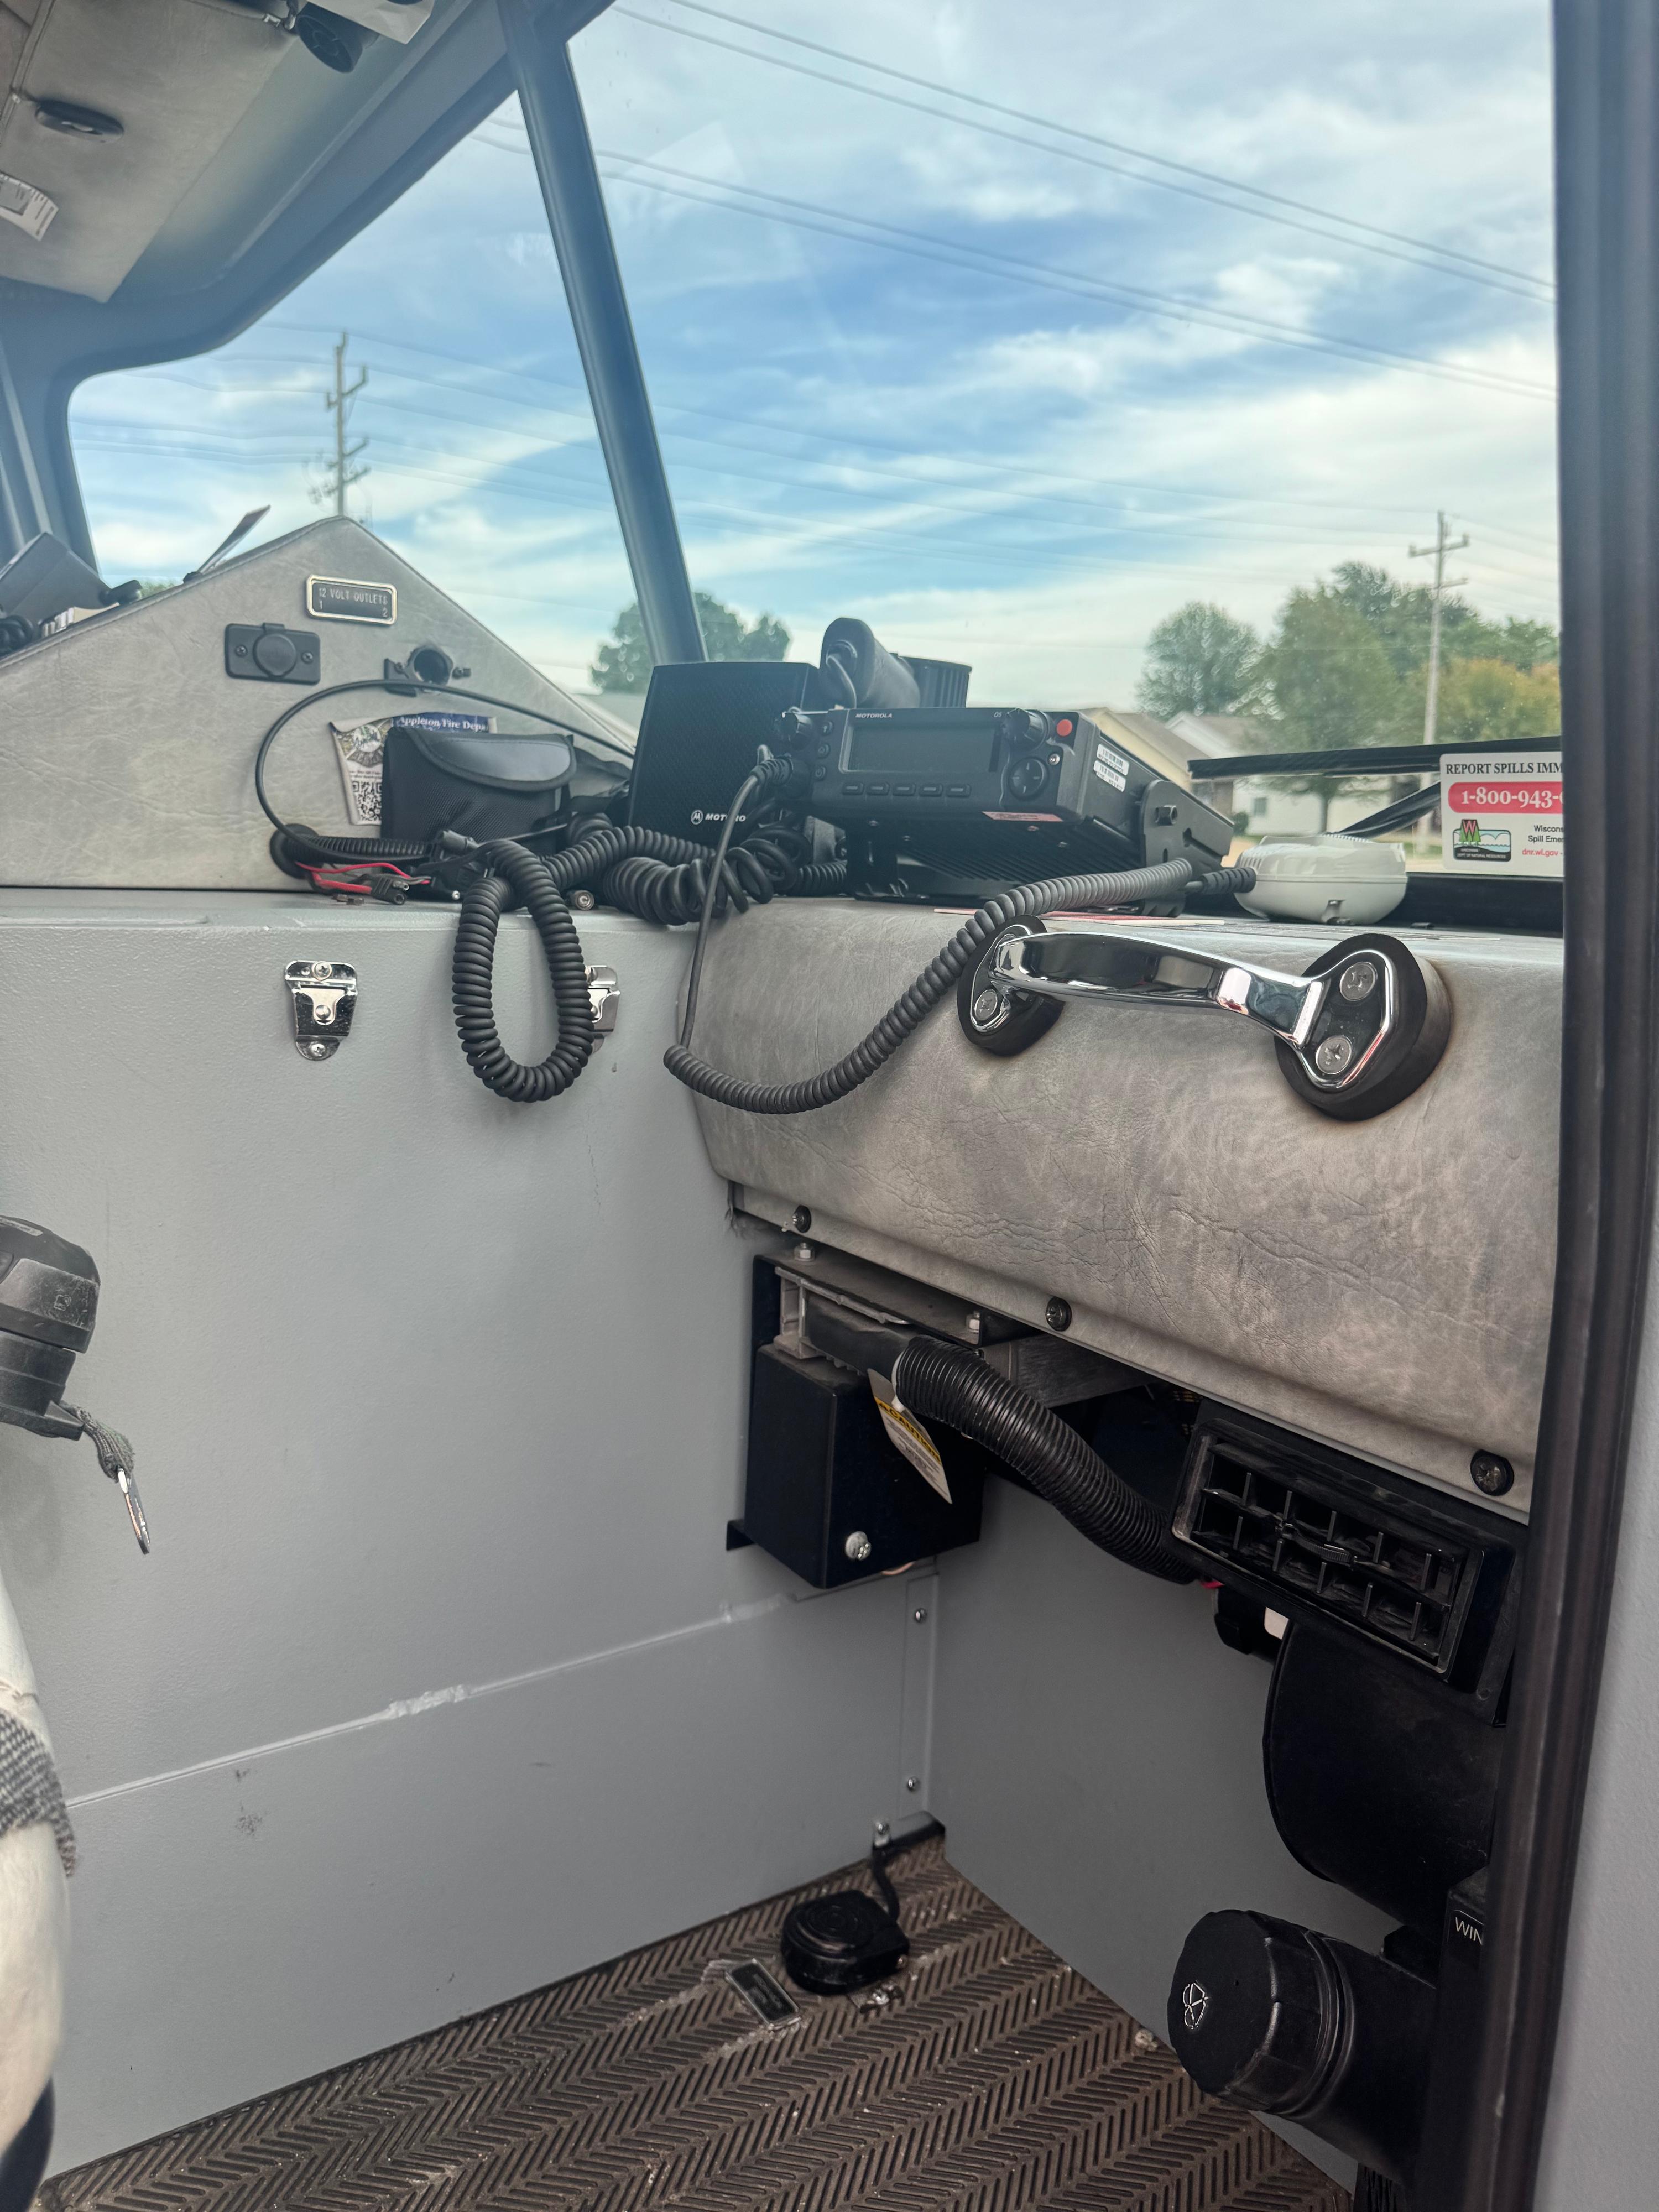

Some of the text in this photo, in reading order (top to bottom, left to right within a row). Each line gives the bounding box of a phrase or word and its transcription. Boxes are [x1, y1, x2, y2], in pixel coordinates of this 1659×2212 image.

[319, 587, 388, 605] 12 VOLT OUTLETS
[319, 600, 323, 609] 1
[383, 608, 388, 618] 2
[1446, 763, 1491, 774] REPORT
[1494, 763, 1534, 774] SPILLS
[1528, 834, 1543, 844] Spill
[1522, 848, 1558, 858] dnr.wi.gov
